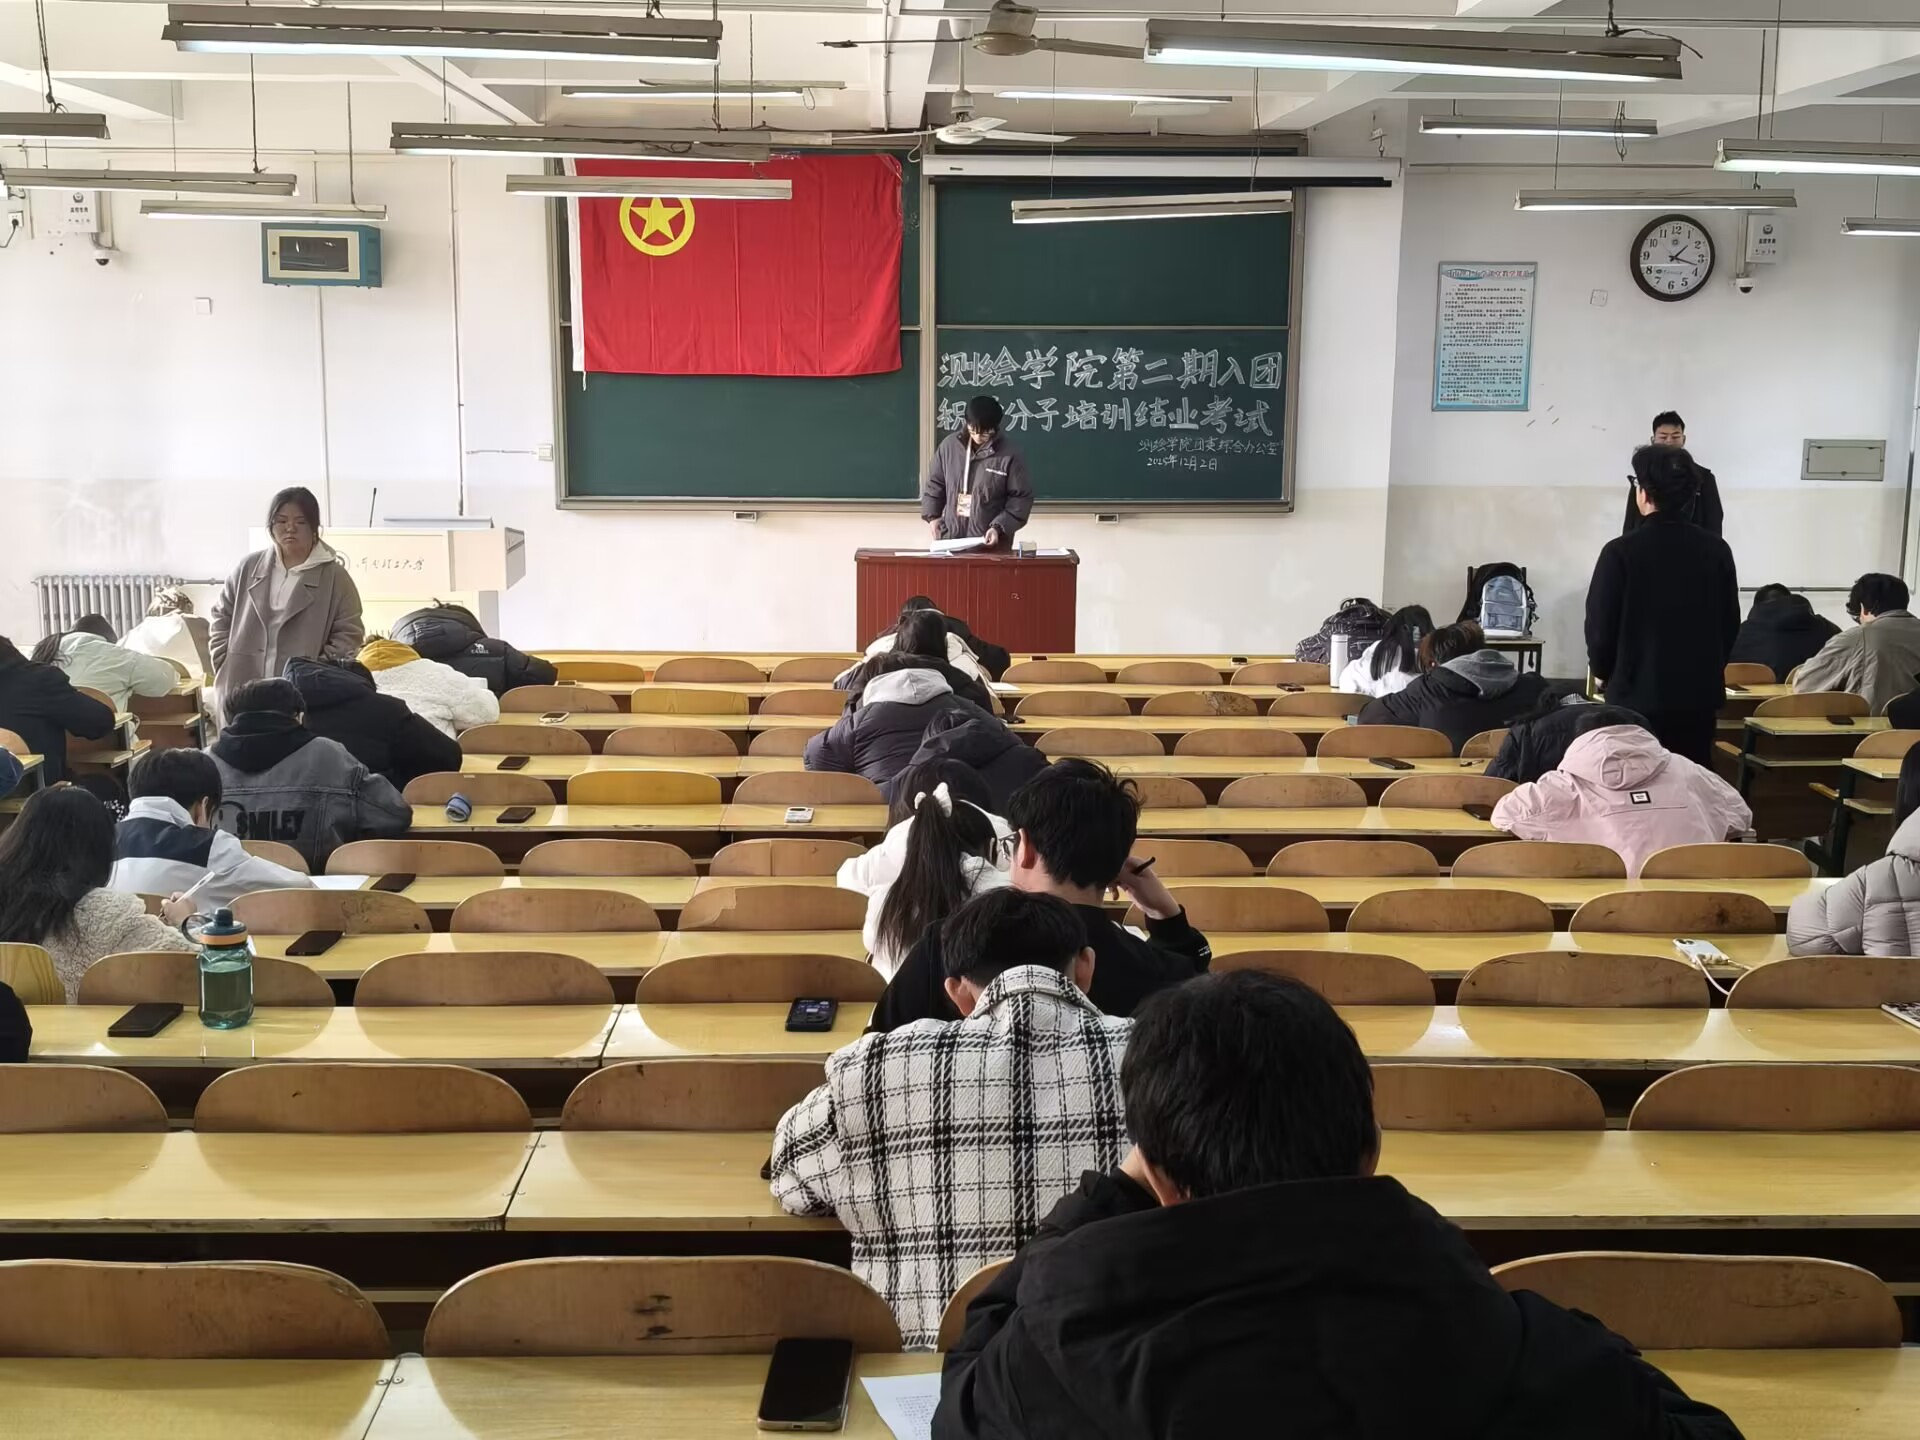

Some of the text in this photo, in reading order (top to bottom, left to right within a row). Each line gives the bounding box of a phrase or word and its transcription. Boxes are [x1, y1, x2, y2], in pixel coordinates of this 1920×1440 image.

[1659, 229, 1667, 239] 11
[1671, 225, 1682, 235] 12
[1686, 230, 1691, 239] 1
[1649, 238, 1658, 248] 10
[1694, 240, 1701, 249] 2
[1643, 252, 1650, 260] 9
[1697, 254, 1705, 263] 3
[1645, 265, 1652, 275] 8
[1691, 267, 1698, 277] 4
[1655, 276, 1662, 285] 7
[1667, 281, 1675, 290] 6
[1681, 277, 1689, 287] 5
[937, 345, 1283, 391] 测绘学院第二期入团
[936, 397, 1274, 436] 积分子培训结业考试
